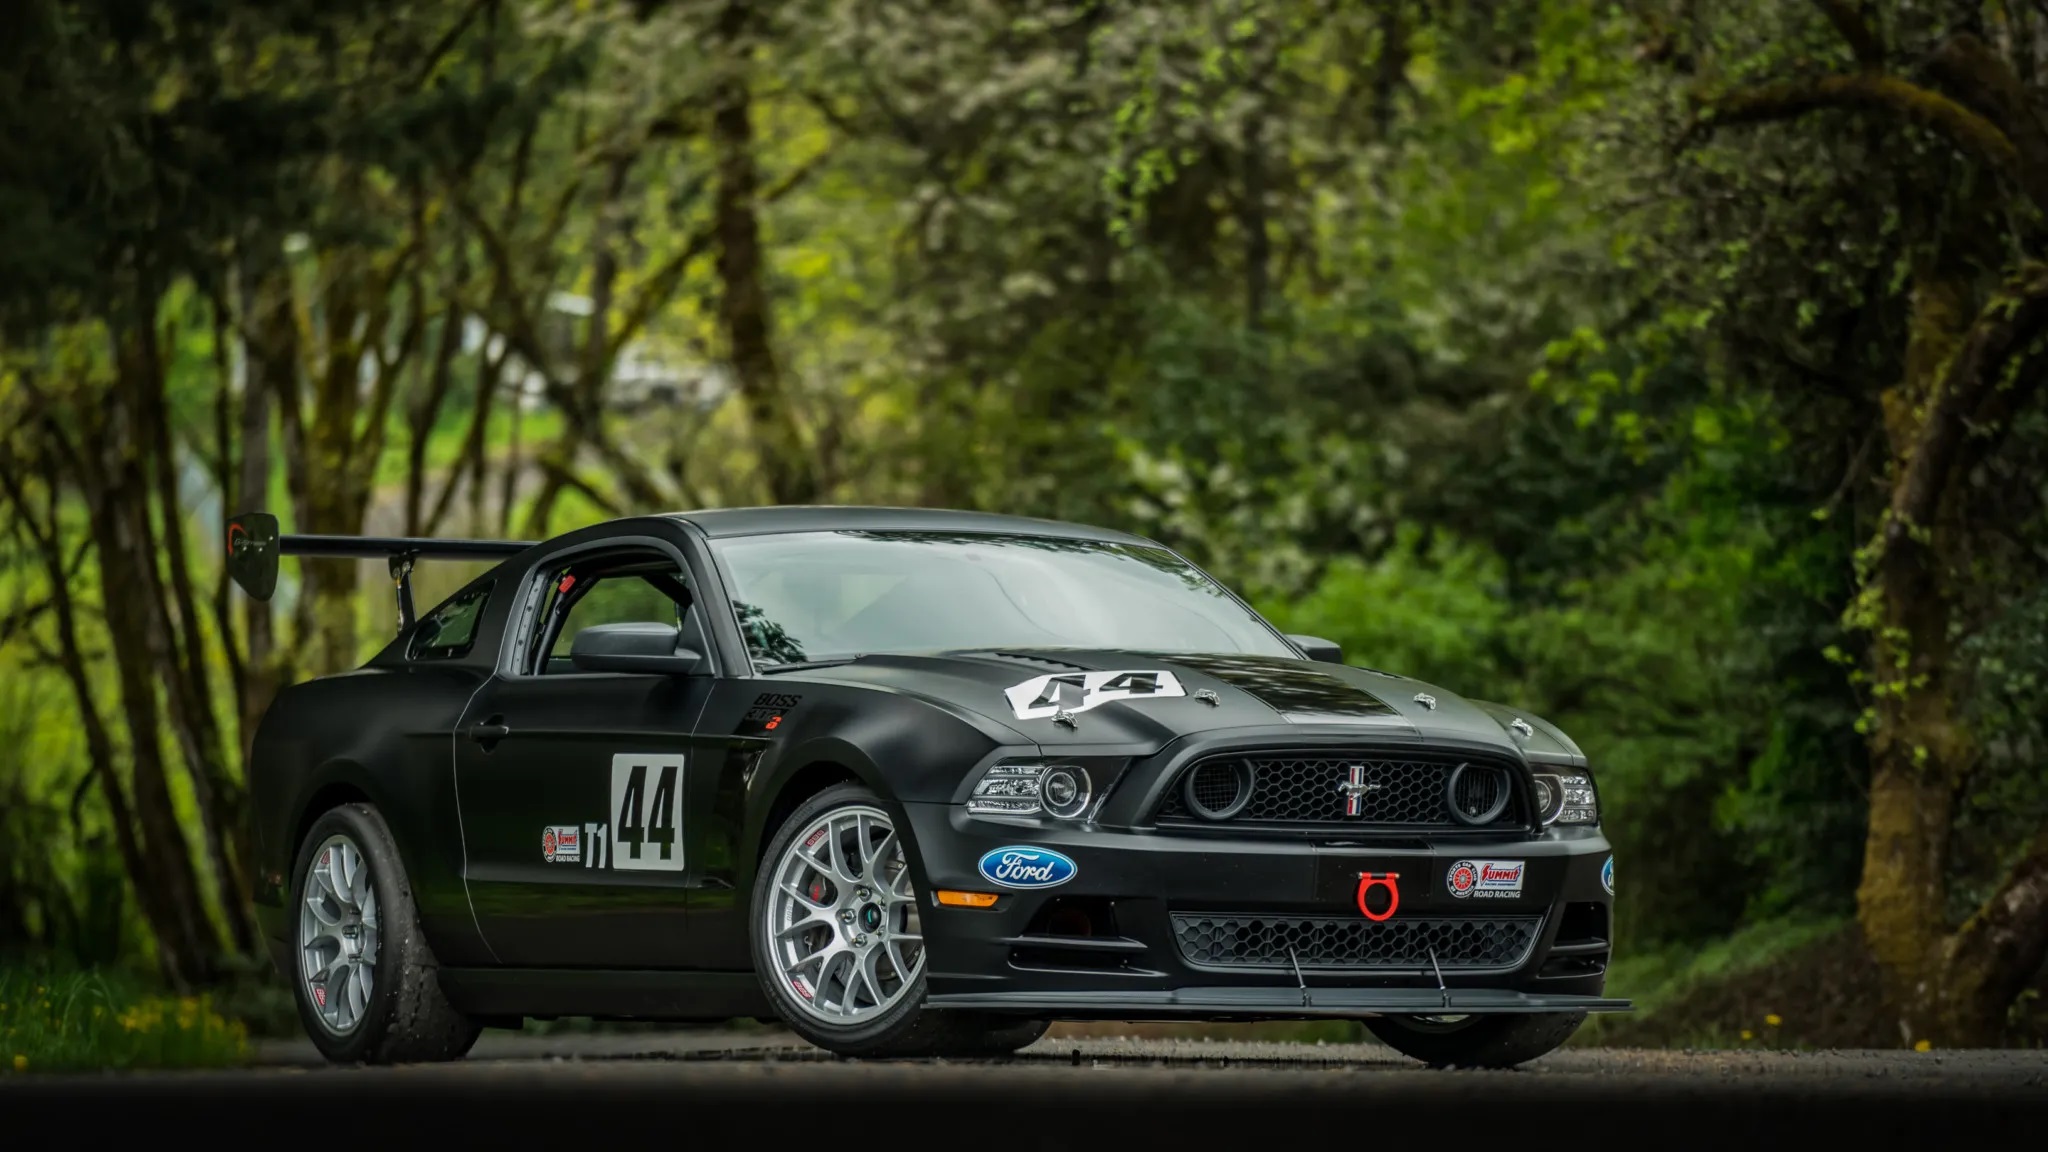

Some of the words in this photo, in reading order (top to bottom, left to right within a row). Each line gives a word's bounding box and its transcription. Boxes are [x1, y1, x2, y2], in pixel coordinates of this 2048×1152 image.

[753, 693, 802, 707] BOSS
[1028, 673, 1163, 710] 44
[618, 766, 678, 860] 44
[585, 823, 607, 868] T1
[996, 852, 1055, 881] Ford
